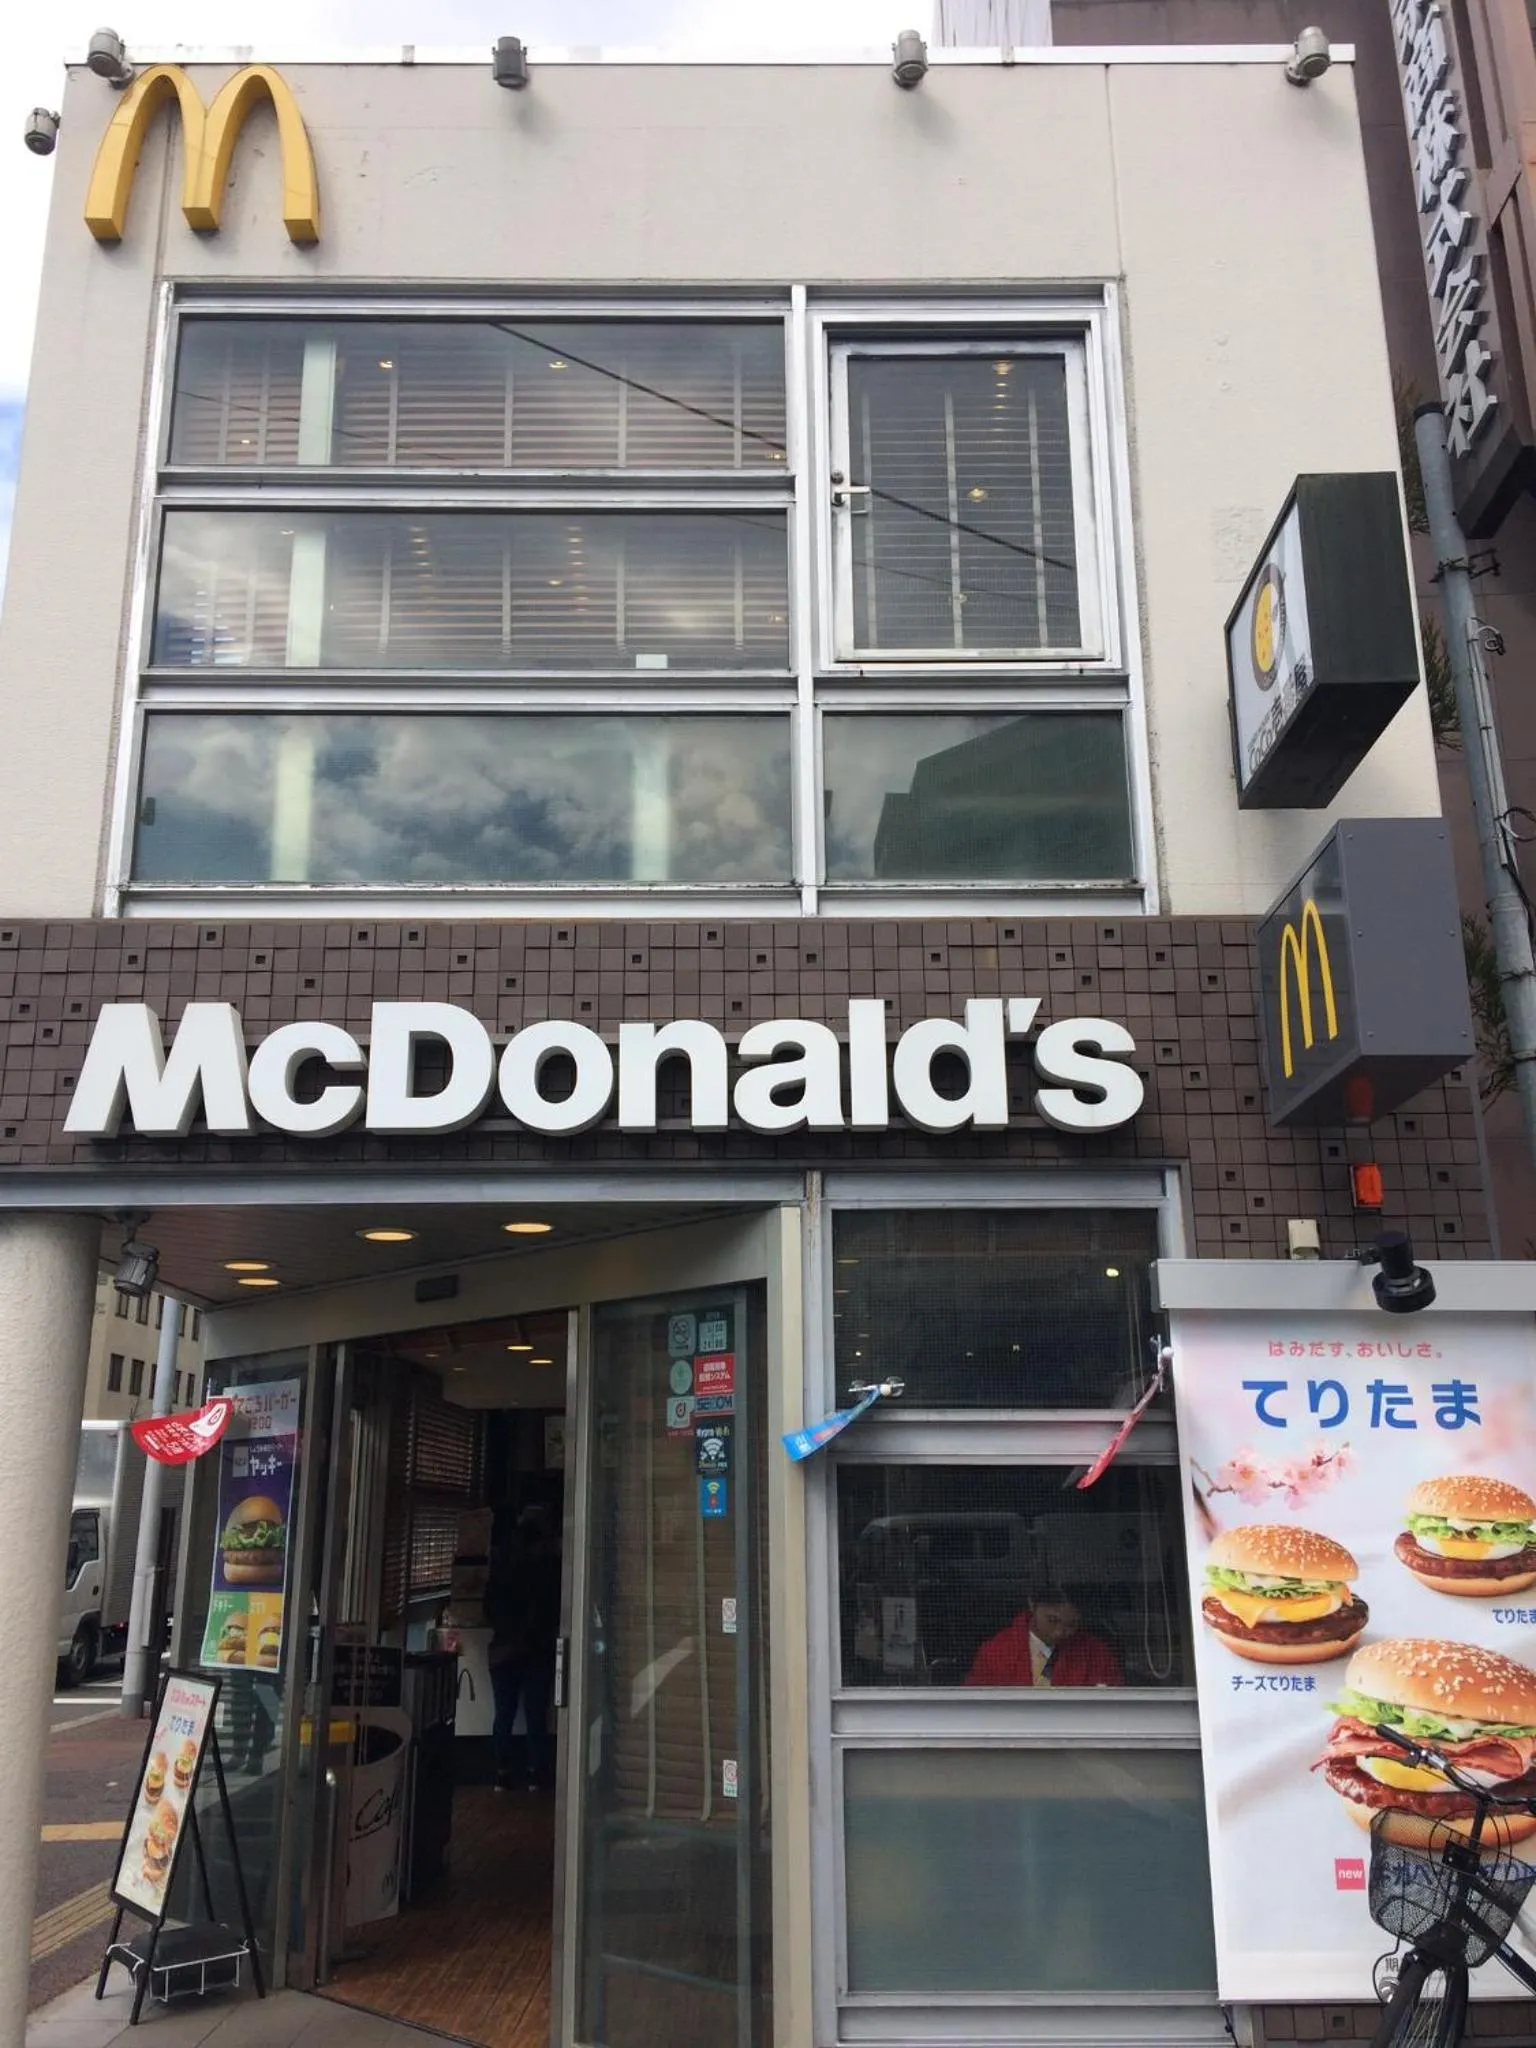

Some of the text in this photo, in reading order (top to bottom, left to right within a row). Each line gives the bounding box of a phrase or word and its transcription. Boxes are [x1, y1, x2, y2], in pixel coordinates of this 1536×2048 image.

[62, 997, 1144, 1138] McDonald's
[1241, 1378, 1482, 1431] てりたま
[1231, 1676, 1317, 1692] チーズてりたま
[1338, 1869, 1364, 1880] new
